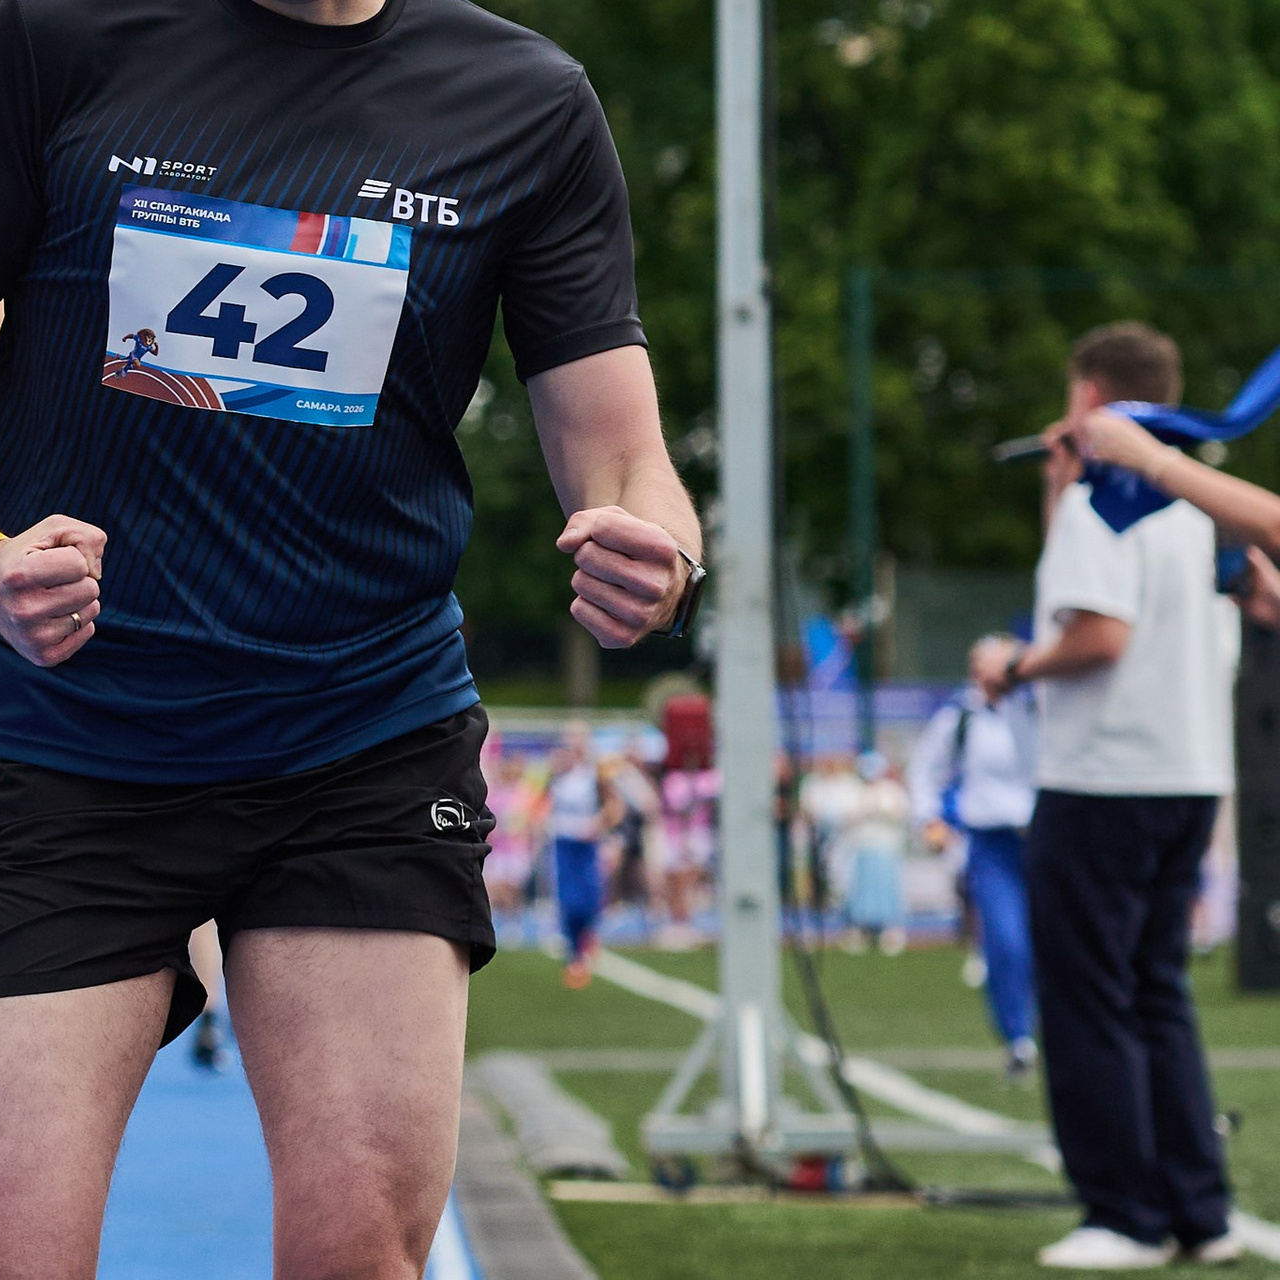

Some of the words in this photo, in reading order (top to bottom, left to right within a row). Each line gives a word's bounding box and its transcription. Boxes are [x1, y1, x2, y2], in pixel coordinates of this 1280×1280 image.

[159, 170, 212, 181] LABORATORY
[161, 160, 217, 176] SPORT
[149, 201, 231, 223] СПАРТАКИАДА
[392, 187, 460, 227] ВТБ
[131, 210, 177, 225] ГРУППЫ
[178, 219, 201, 228] ВТБ
[165, 262, 335, 373] 42
[296, 399, 342, 413] САМАРА
[343, 405, 365, 413] 2026
